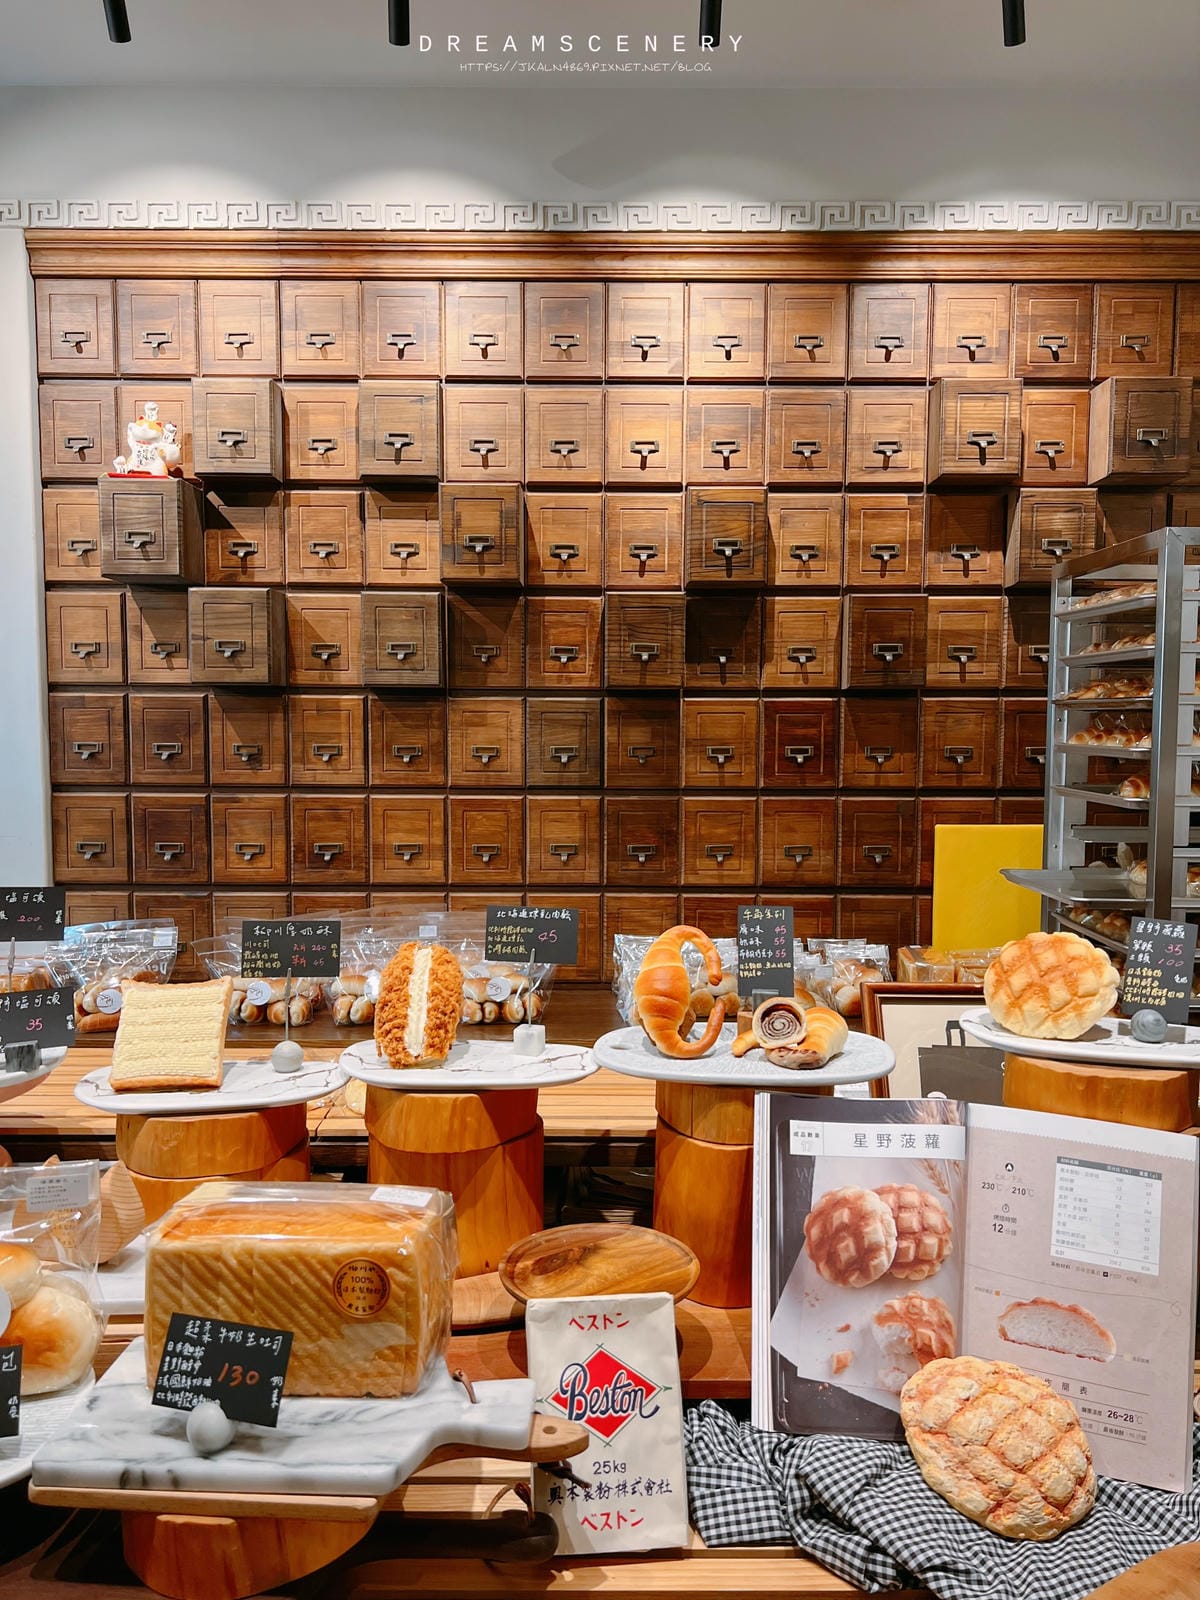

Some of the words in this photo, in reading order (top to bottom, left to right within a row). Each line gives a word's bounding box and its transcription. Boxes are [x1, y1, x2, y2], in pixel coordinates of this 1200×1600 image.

[538, 929, 558, 943] 45
[774, 925, 787, 935] 45
[774, 936, 785, 946] 55
[775, 949, 787, 959] 55
[1165, 944, 1184, 956] 35
[1157, 959, 1184, 967] 100
[25, 1017, 43, 1031] 35
[852, 1132, 942, 1150] 星野菠蘿
[568, 1312, 630, 1331] ベストン
[217, 1362, 260, 1387] 130
[560, 1363, 660, 1421] Beston
[592, 1460, 627, 1475] 25kg
[580, 1509, 644, 1531] ベストン
